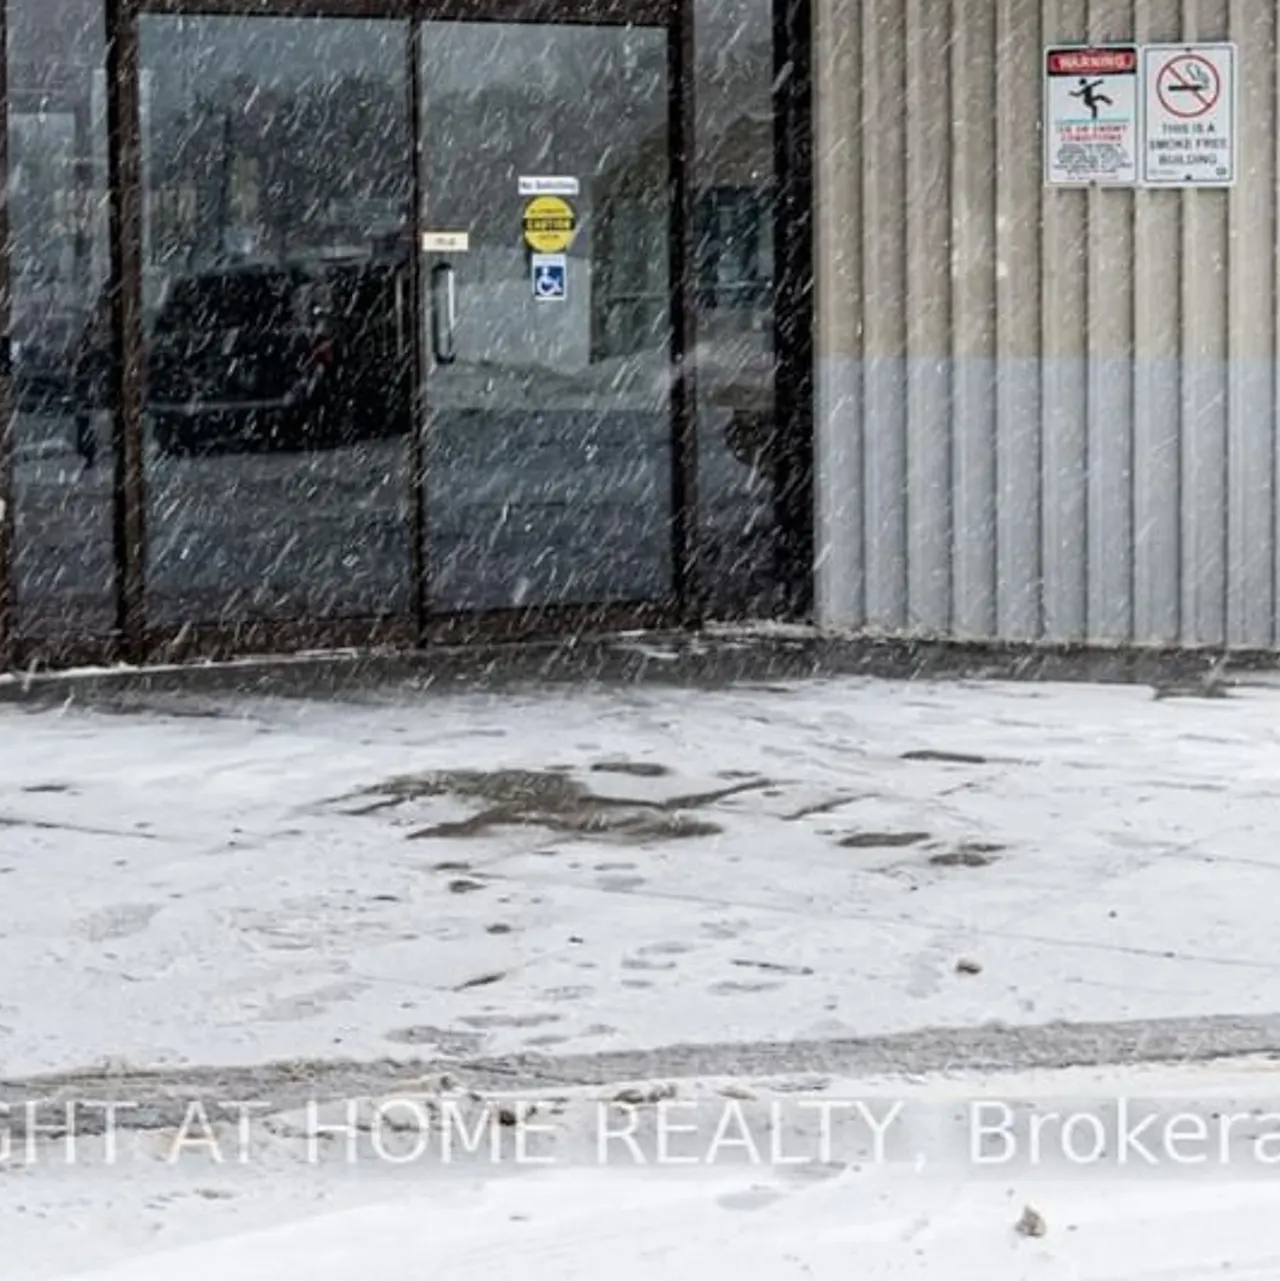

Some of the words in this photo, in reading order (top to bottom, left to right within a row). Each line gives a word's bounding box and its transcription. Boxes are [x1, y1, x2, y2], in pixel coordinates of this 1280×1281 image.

[1059, 53, 1124, 70] WARNING
[1163, 123, 1189, 134] THIS
[1192, 123, 1203, 133] IS
[1207, 122, 1215, 132] A
[1150, 139, 1192, 150] SMOKE
[1196, 138, 1227, 149] FREE
[1159, 153, 1217, 165] BUILDING
[527, 218, 572, 231] CAUTION
